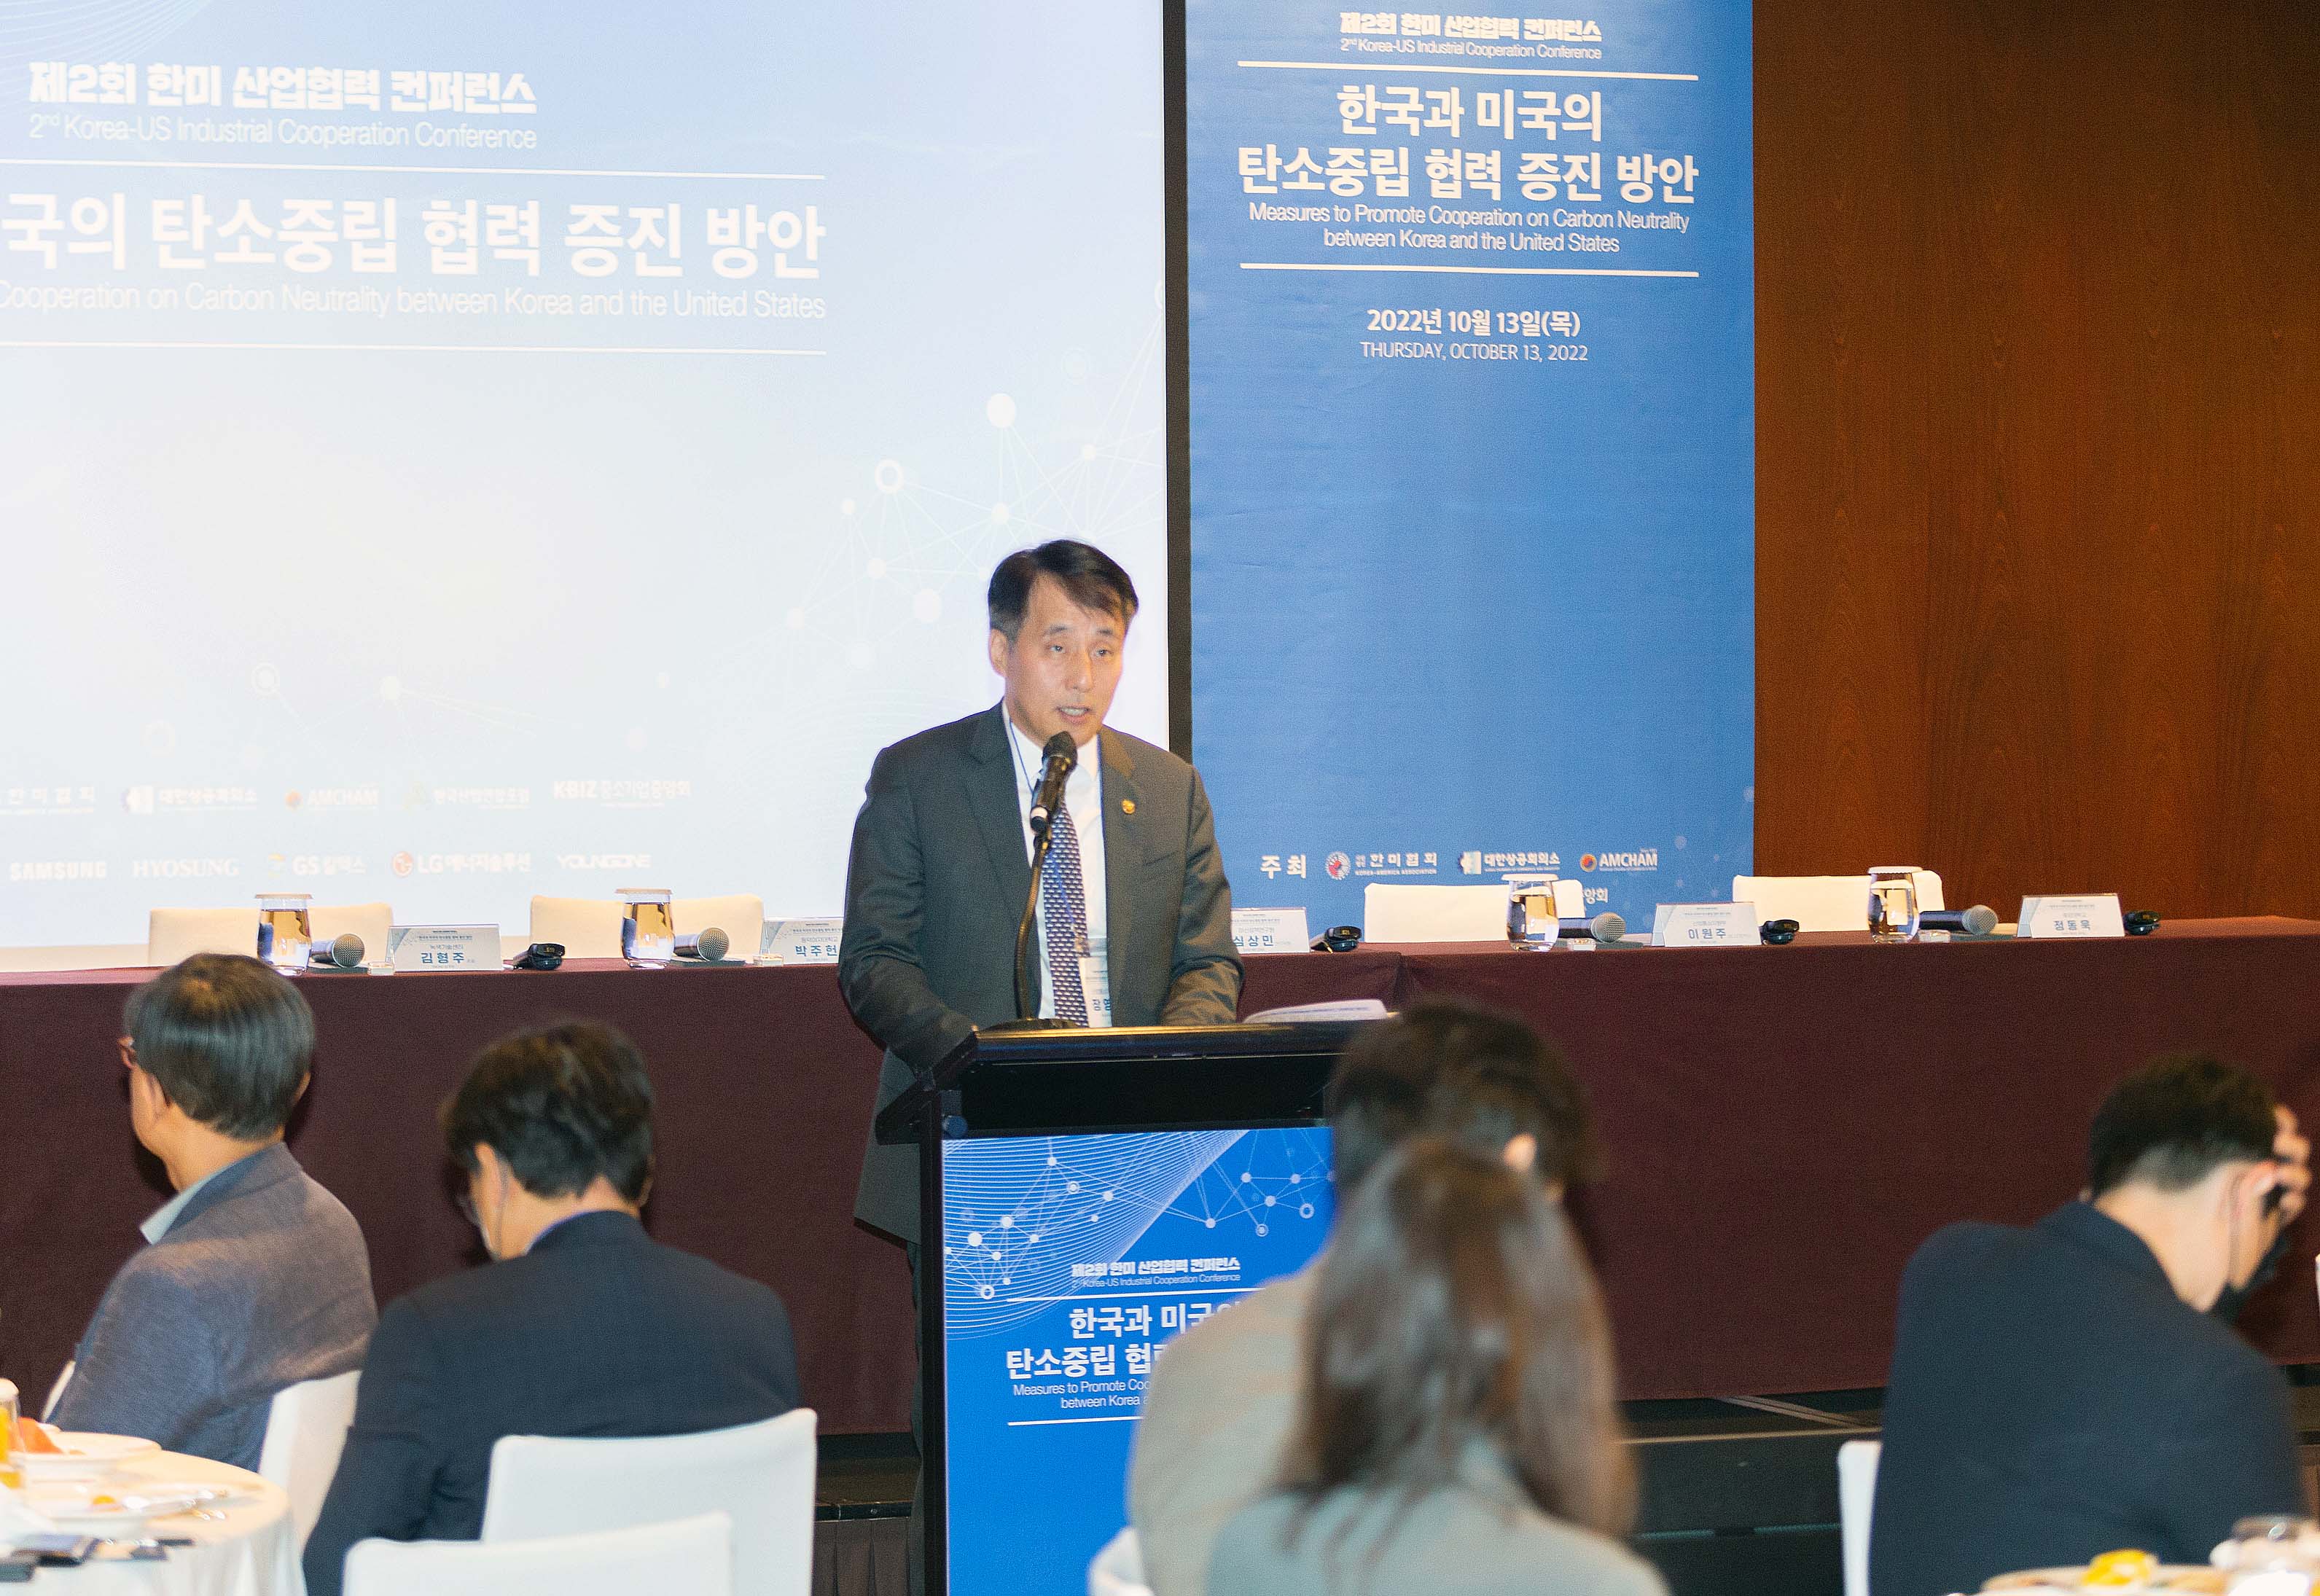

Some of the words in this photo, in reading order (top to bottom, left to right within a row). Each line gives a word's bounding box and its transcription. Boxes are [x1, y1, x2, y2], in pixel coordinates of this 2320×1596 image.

[1340, 11, 1397, 36] 제2회
[1400, 13, 1441, 37] 한미
[1445, 15, 1520, 40] 산업협력
[1523, 17, 1602, 42] 컨퍼런스
[1358, 38, 1414, 54] Korea-US
[1417, 40, 1464, 55] Industrial
[1465, 42, 1534, 59] Cooperation
[1537, 43, 1601, 60] Conference
[29, 63, 136, 105] 제2회
[147, 63, 221, 107] 한미
[233, 66, 380, 112] 산업협력
[390, 70, 537, 114] 컨퍼런스
[1337, 84, 1464, 138] 한국과
[1477, 88, 1601, 142] 미국의
[29, 113, 60, 139] 2nd
[65, 114, 171, 141] Korea-US
[178, 117, 273, 144] Industrial
[278, 120, 409, 149] Cooperation
[415, 121, 537, 149] Conference
[1238, 144, 1409, 197] 탄소중립
[1425, 147, 1501, 200] 협력
[1517, 151, 1601, 202] 증진
[1617, 154, 1698, 204] 방안
[1249, 203, 1330, 222] Measures
[1333, 206, 1351, 222] to
[1355, 204, 1426, 224] Promote
[1429, 207, 1523, 230] Cooperation
[1527, 212, 1549, 227] on
[1552, 209, 1614, 229] Carbon
[1618, 211, 1690, 233] Neutrality
[1, 192, 126, 270] 국의
[152, 194, 397, 274] 탄소중립
[422, 199, 539, 276] 협력
[565, 203, 683, 278] 증진
[707, 204, 827, 279] 방안
[1324, 227, 1396, 248] between
[1399, 230, 1447, 249] Korea
[1449, 231, 1478, 250] and
[1481, 232, 1507, 251] the
[1509, 232, 1564, 251] United
[1568, 233, 1620, 253] States
[149, 286, 179, 310] on
[185, 282, 276, 311] Carbon
[283, 285, 391, 318] Neutrality
[397, 286, 497, 314] between
[504, 286, 574, 316] Korea
[578, 290, 623, 316] and
[630, 291, 667, 317] the
[673, 290, 747, 318] United
[754, 290, 826, 319] States
[1367, 308, 1442, 335] 2022년
[1448, 309, 1491, 337] 10월
[1496, 310, 1581, 337] 13일(목)
[1361, 341, 1446, 361] THURSDAY,
[1450, 343, 1518, 361] OCTOBER
[1523, 344, 1543, 363] 13,
[1548, 345, 1588, 361] 2022
[11, 862, 106, 880] SAMSUNG
[132, 859, 239, 877] HYOSUNG
[1260, 854, 1306, 879] 주최
[1600, 853, 1657, 867] AMCHAM
[1582, 888, 1608, 904] 앙회
[1234, 935, 1273, 947] 심상민
[1688, 928, 1726, 939] 이원주
[421, 952, 464, 963] 김형주
[795, 944, 837, 957] 박주헌
[1071, 1262, 1108, 1278] 제2회
[1110, 1261, 1136, 1275] 한미
[1138, 1259, 1189, 1275] 산업협력
[1190, 1257, 1241, 1272] 컨퍼런스
[1083, 1277, 1118, 1288] Korea-US
[1120, 1275, 1151, 1286] Industrial
[1153, 1274, 1197, 1286] Cooperation
[1199, 1272, 1241, 1283] Conference
[1069, 1306, 1152, 1339] 한국과
[1007, 1344, 1114, 1380] 탄소중립
[1014, 1382, 1065, 1396] Measures
[1067, 1383, 1078, 1393] to
[1081, 1380, 1125, 1393] Promote
[1061, 1395, 1106, 1409] between
[1109, 1394, 1140, 1407] Korea
